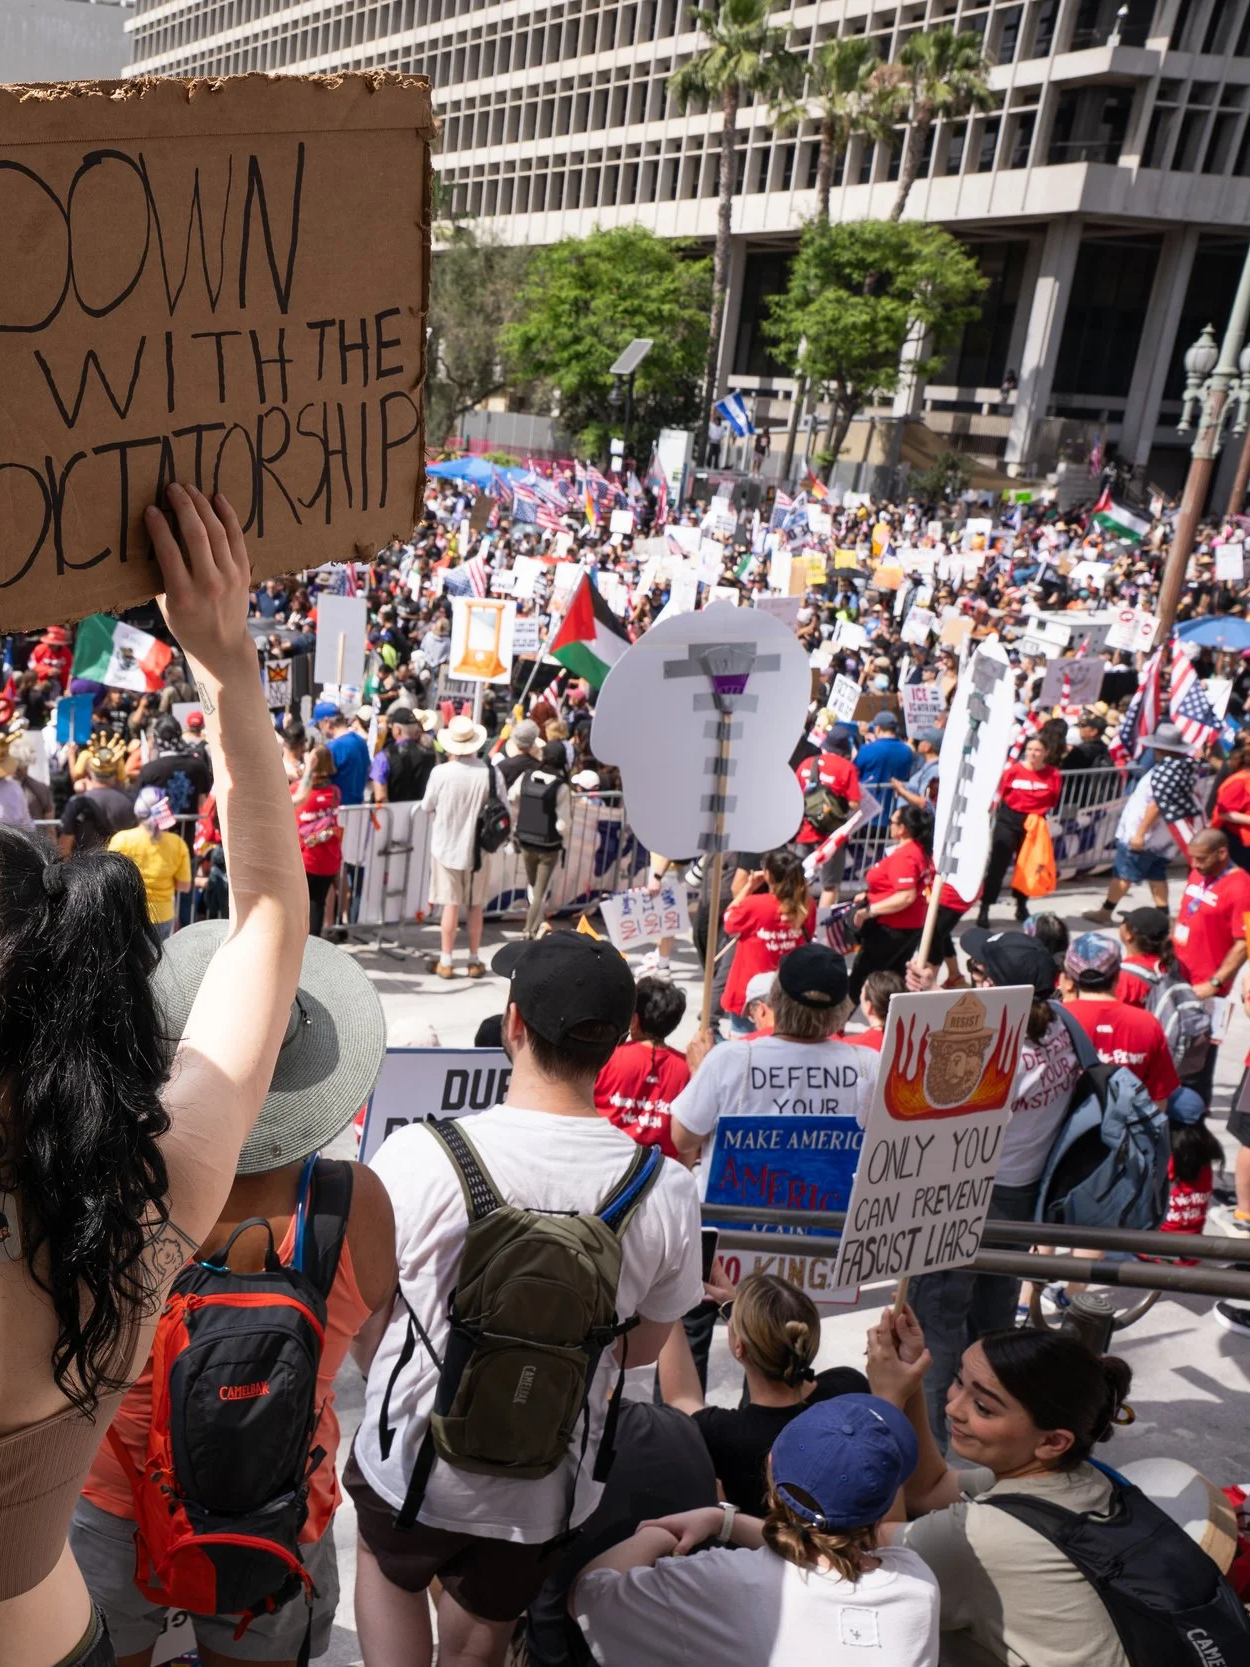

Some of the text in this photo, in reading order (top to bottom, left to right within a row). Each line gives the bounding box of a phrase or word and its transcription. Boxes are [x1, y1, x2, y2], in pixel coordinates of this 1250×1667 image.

[34, 307, 405, 429] WITH THE
[911, 688, 928, 702] ICE
[949, 1014, 980, 1029] RESIST
[751, 1066, 858, 1090] DEFEND
[773, 1098, 839, 1115] YOUR
[723, 1129, 866, 1150] MAKE AMERIC
[867, 1124, 1002, 1185] ONLY YOU
[719, 1156, 842, 1211] AMERIC
[854, 1175, 995, 1233] CAN PREVENT
[837, 1215, 983, 1288] FASCIST LIARS
[753, 1255, 836, 1290] KING
[219, 1380, 271, 1401] CAMELBAK
[513, 1365, 538, 1405] CAMELBAK
